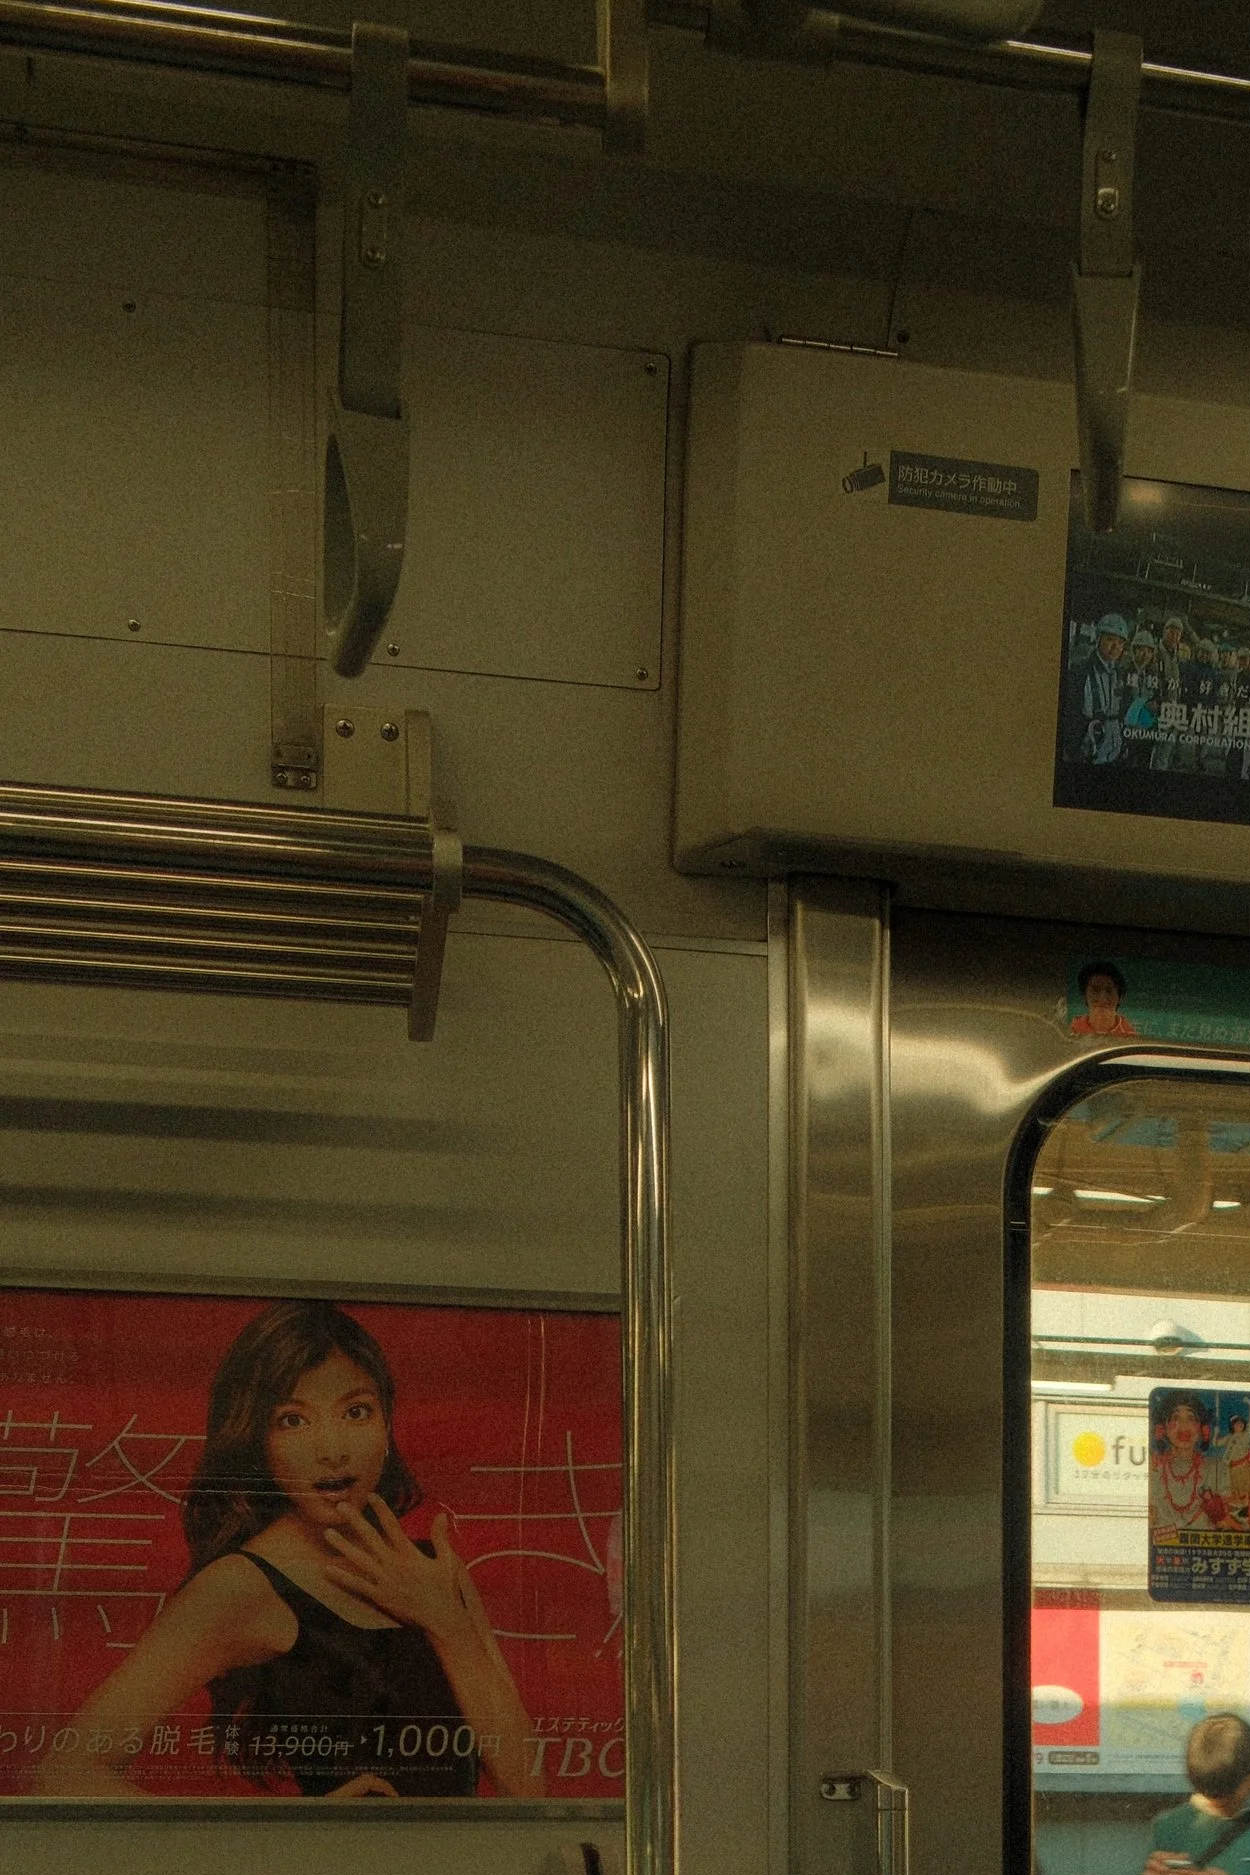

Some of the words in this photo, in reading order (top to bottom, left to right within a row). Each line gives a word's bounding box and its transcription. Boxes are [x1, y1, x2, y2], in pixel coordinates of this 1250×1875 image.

[897, 484, 932, 498] Security
[898, 464, 1017, 495] 防犯カメラ作動中
[1123, 728, 1176, 743] OKUMURA
[224, 1724, 241, 1756] 体験
[523, 1737, 625, 1777] TBC
